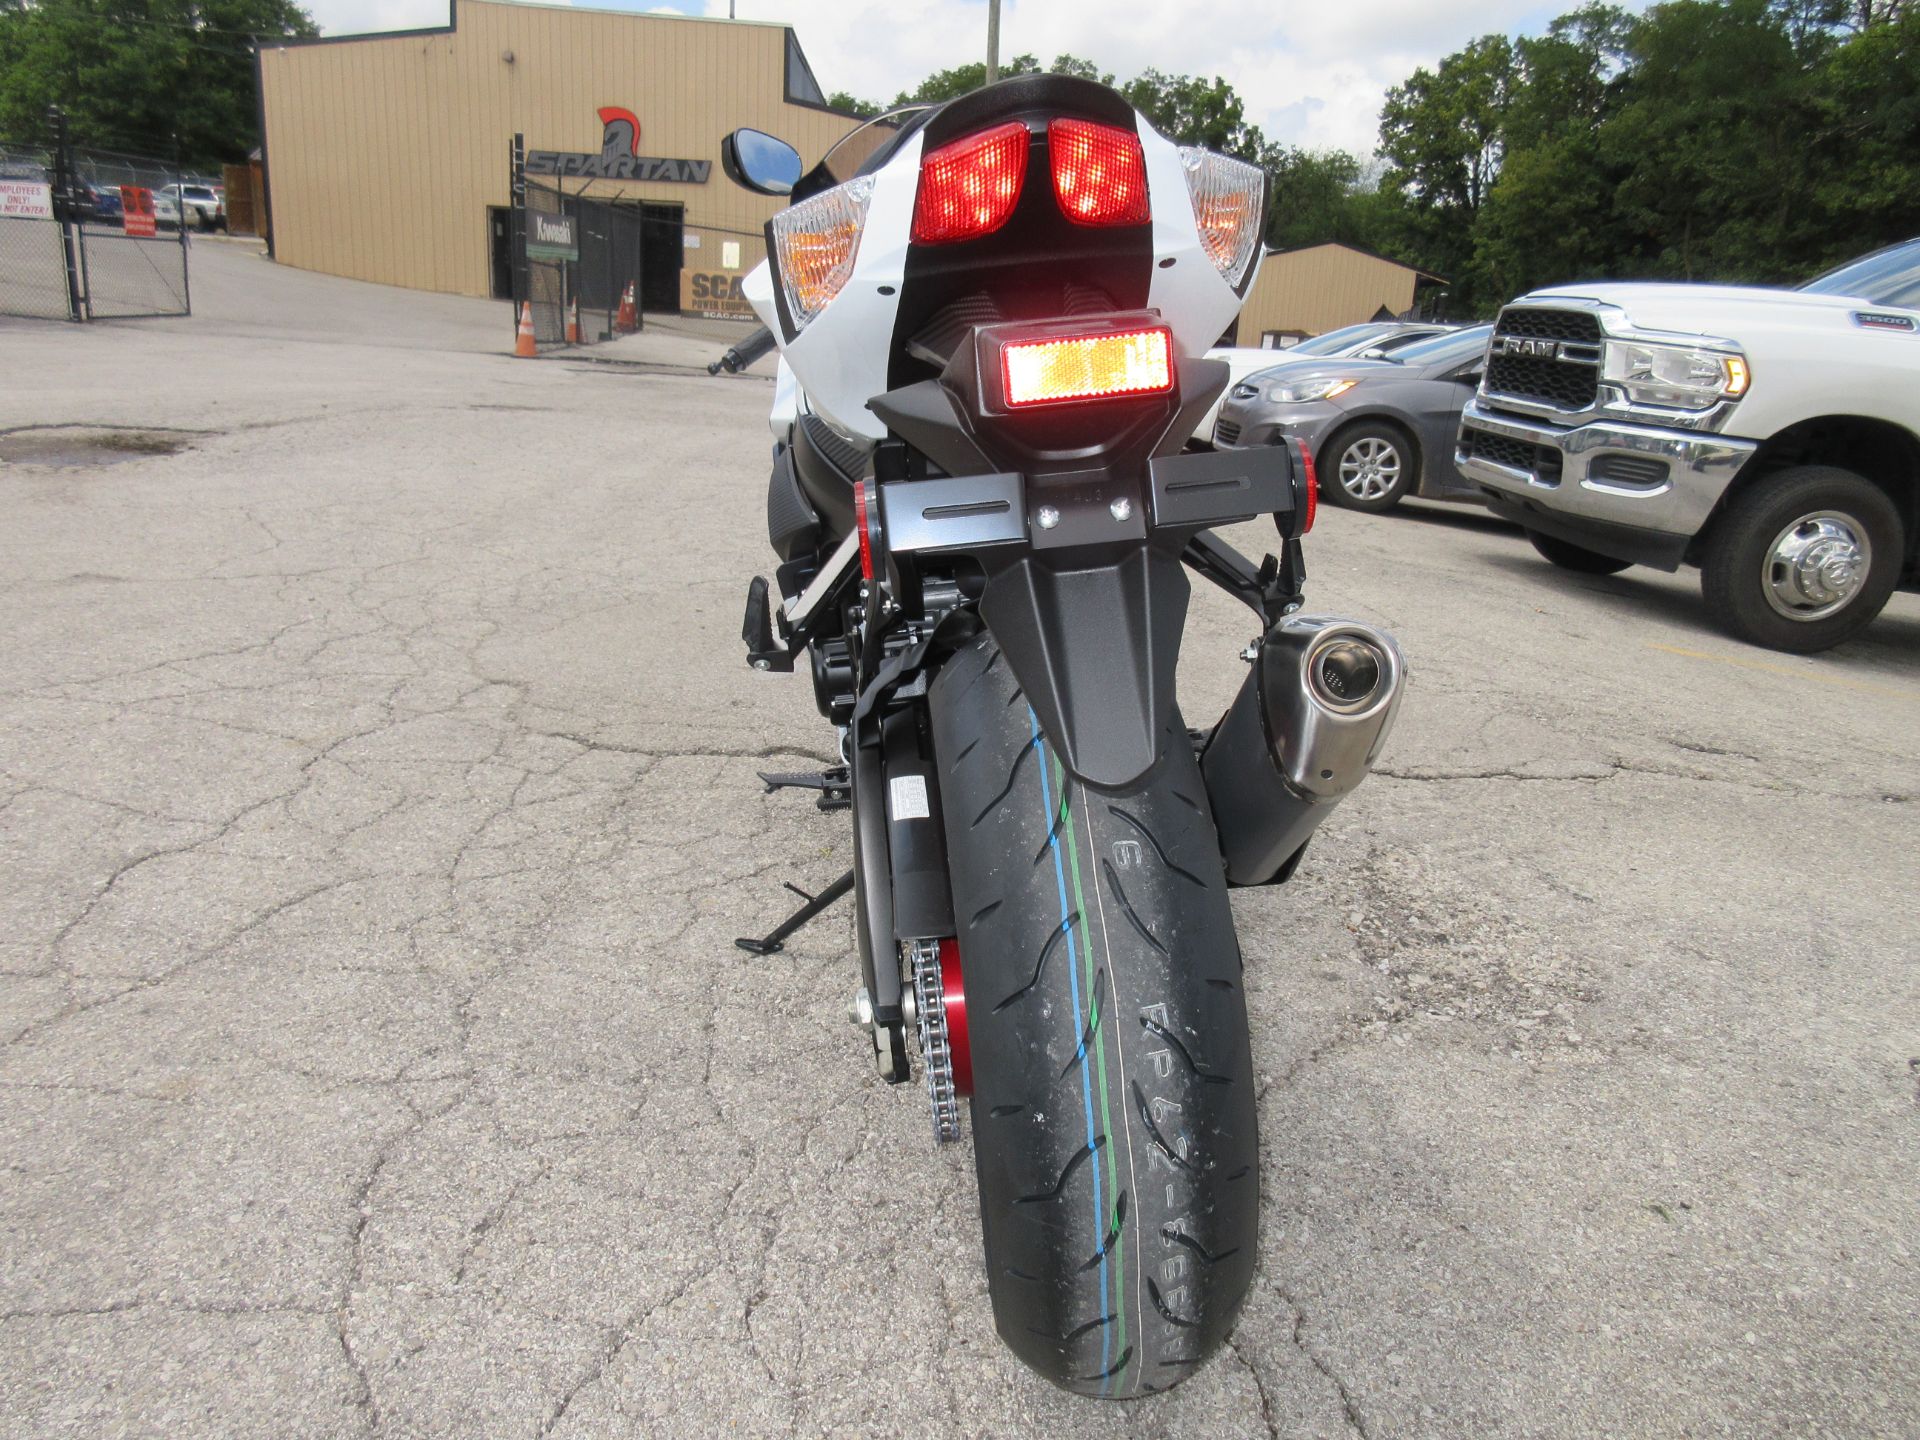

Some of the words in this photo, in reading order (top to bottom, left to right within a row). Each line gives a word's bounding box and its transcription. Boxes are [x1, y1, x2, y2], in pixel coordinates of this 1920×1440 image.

[526, 151, 712, 183] SPARTAN
[7, 196, 30, 205] ONLY!
[4, 205, 18, 213] NOT
[19, 205, 49, 216] ENTER!
[536, 216, 571, 244] Kawasaki
[692, 299, 720, 310] POWER
[1858, 314, 1908, 325] 3500
[1503, 338, 1557, 358] RAM
